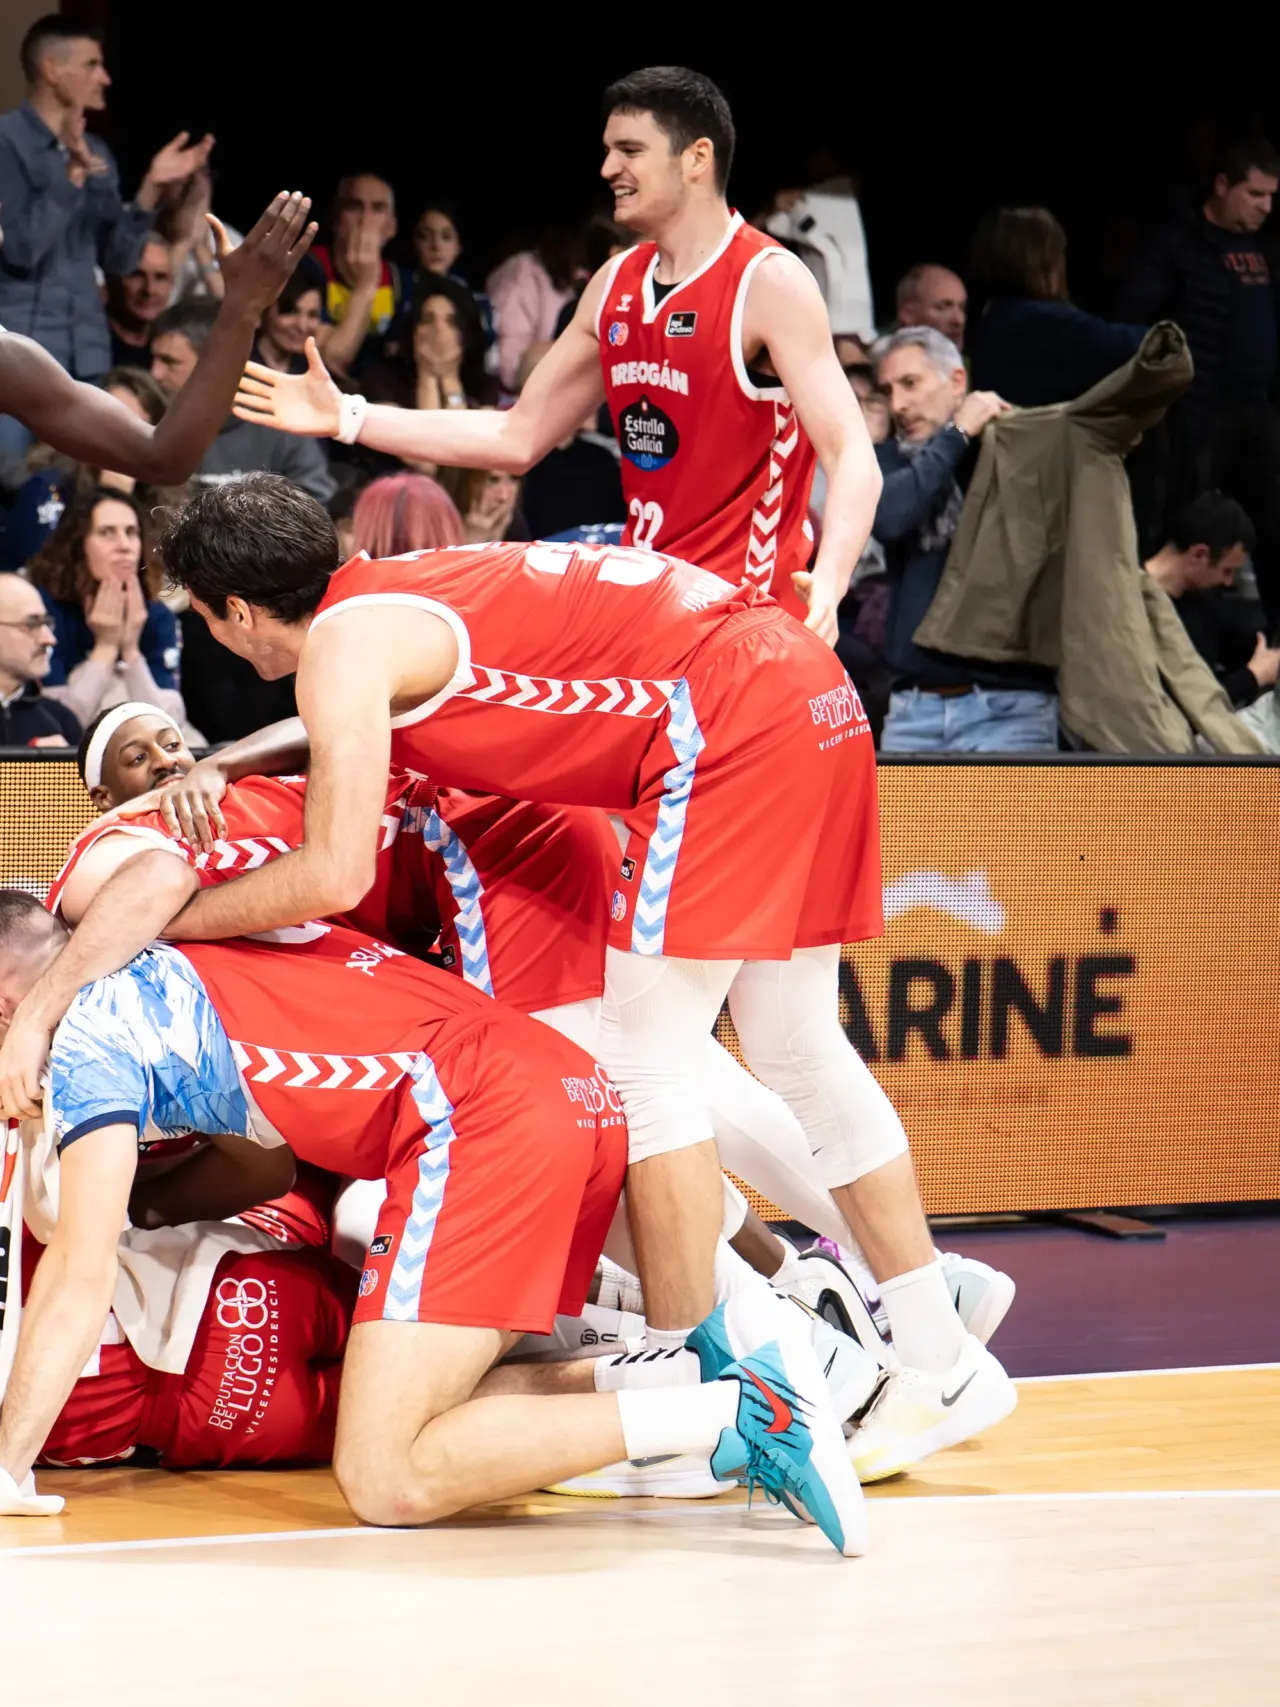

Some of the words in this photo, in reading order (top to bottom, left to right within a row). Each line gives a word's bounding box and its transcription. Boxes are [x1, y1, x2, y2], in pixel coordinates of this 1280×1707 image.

[624, 414, 665, 436] Estrella
[626, 433, 664, 454] Galicia
[629, 497, 665, 551] 22
[811, 708, 828, 726] DE
[370, 1243, 385, 1254] acb
[245, 1279, 280, 1434] VICEPRESIDENCIA
[208, 1333, 242, 1427] DEPUTACIÓN
[227, 1333, 265, 1412] LUGO
[220, 1411, 238, 1431] DE
